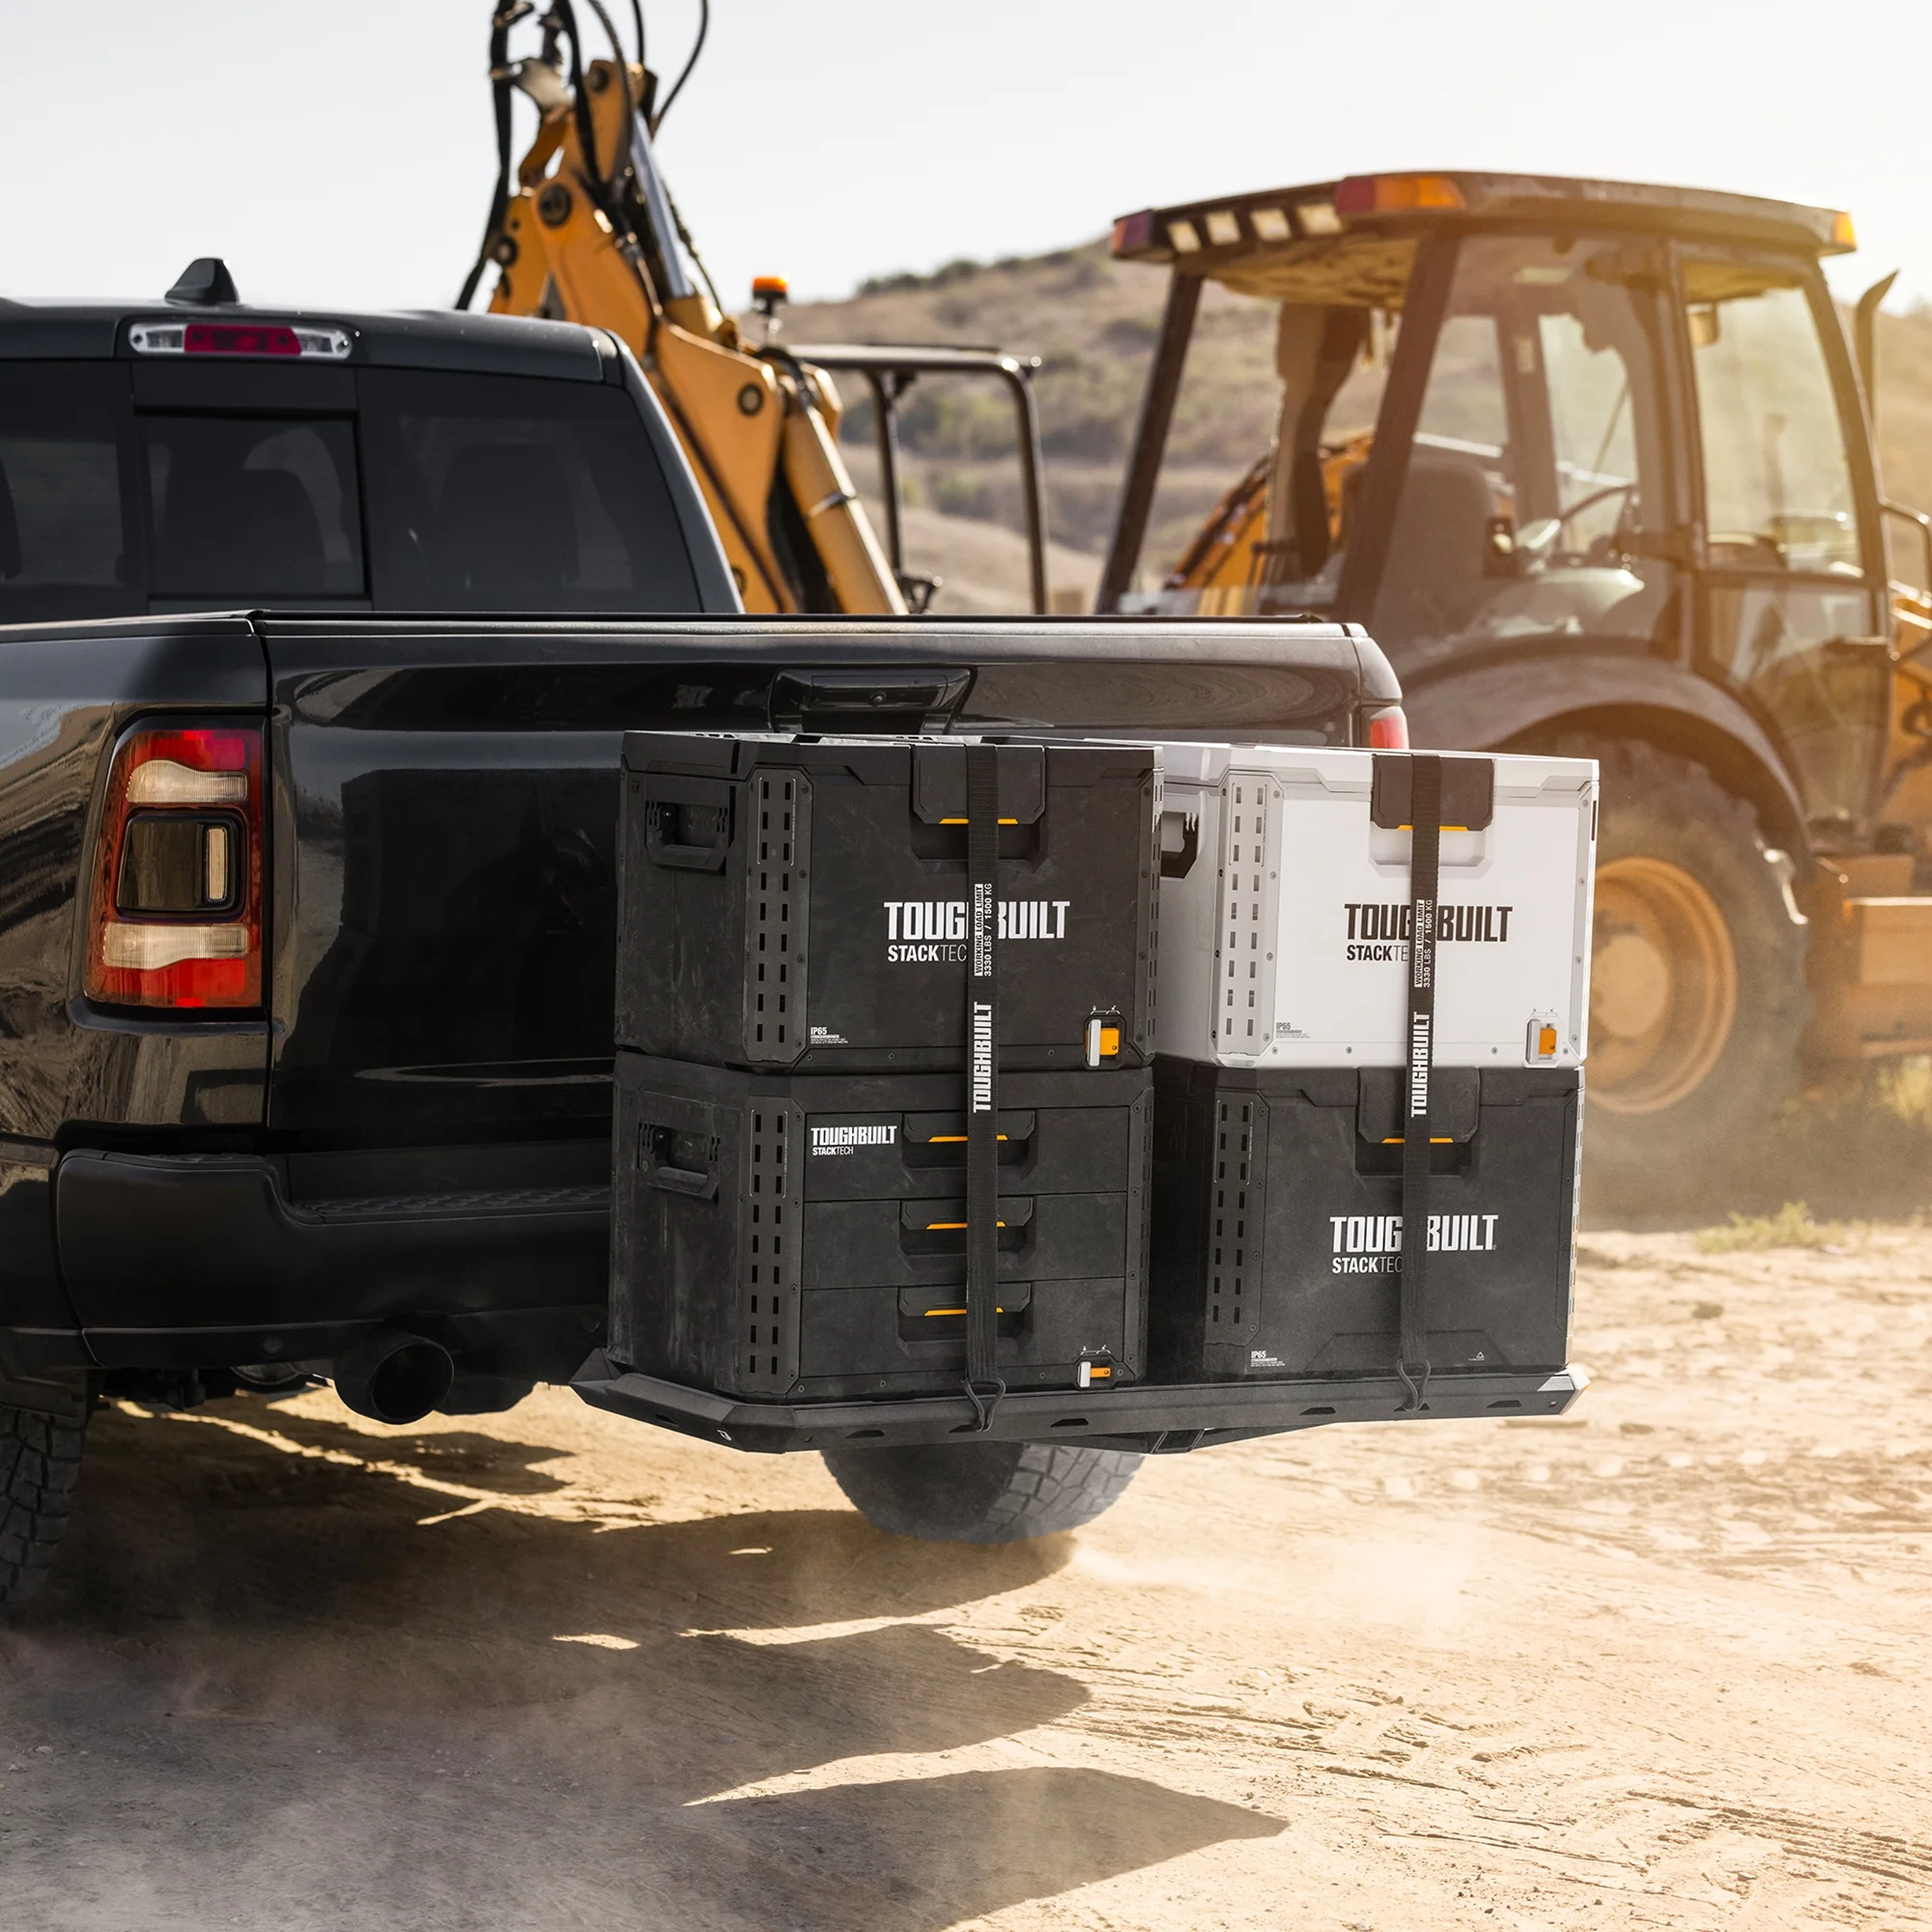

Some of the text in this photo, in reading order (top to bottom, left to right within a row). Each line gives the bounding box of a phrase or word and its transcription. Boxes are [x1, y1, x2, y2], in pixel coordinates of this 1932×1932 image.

[983, 883, 993, 895] KG
[983, 897, 992, 920] 1500
[1425, 899, 1434, 911] KG
[884, 901, 1070, 940] TOUGUILT
[975, 910, 983, 932] LOAD
[1344, 903, 1513, 942] TOUGBUILT
[887, 944, 967, 962] STACKTEC
[975, 934, 983, 974] WORKING
[983, 934, 992, 952] LBS
[1347, 944, 1408, 962] STACKTE
[983, 953, 992, 977] 3330
[1415, 948, 1424, 985] WORKING
[810, 1026, 828, 1035] IP65
[973, 1001, 992, 1114] TOUGHBUILT
[1410, 1010, 1431, 1118] TOUGHBUILT
[810, 1125, 897, 1146] TOUGHBUILT
[812, 1146, 854, 1156] STACKTECH
[1329, 1214, 1499, 1253] TOUGBUILT
[1331, 1256, 1404, 1274] STACKTEC
